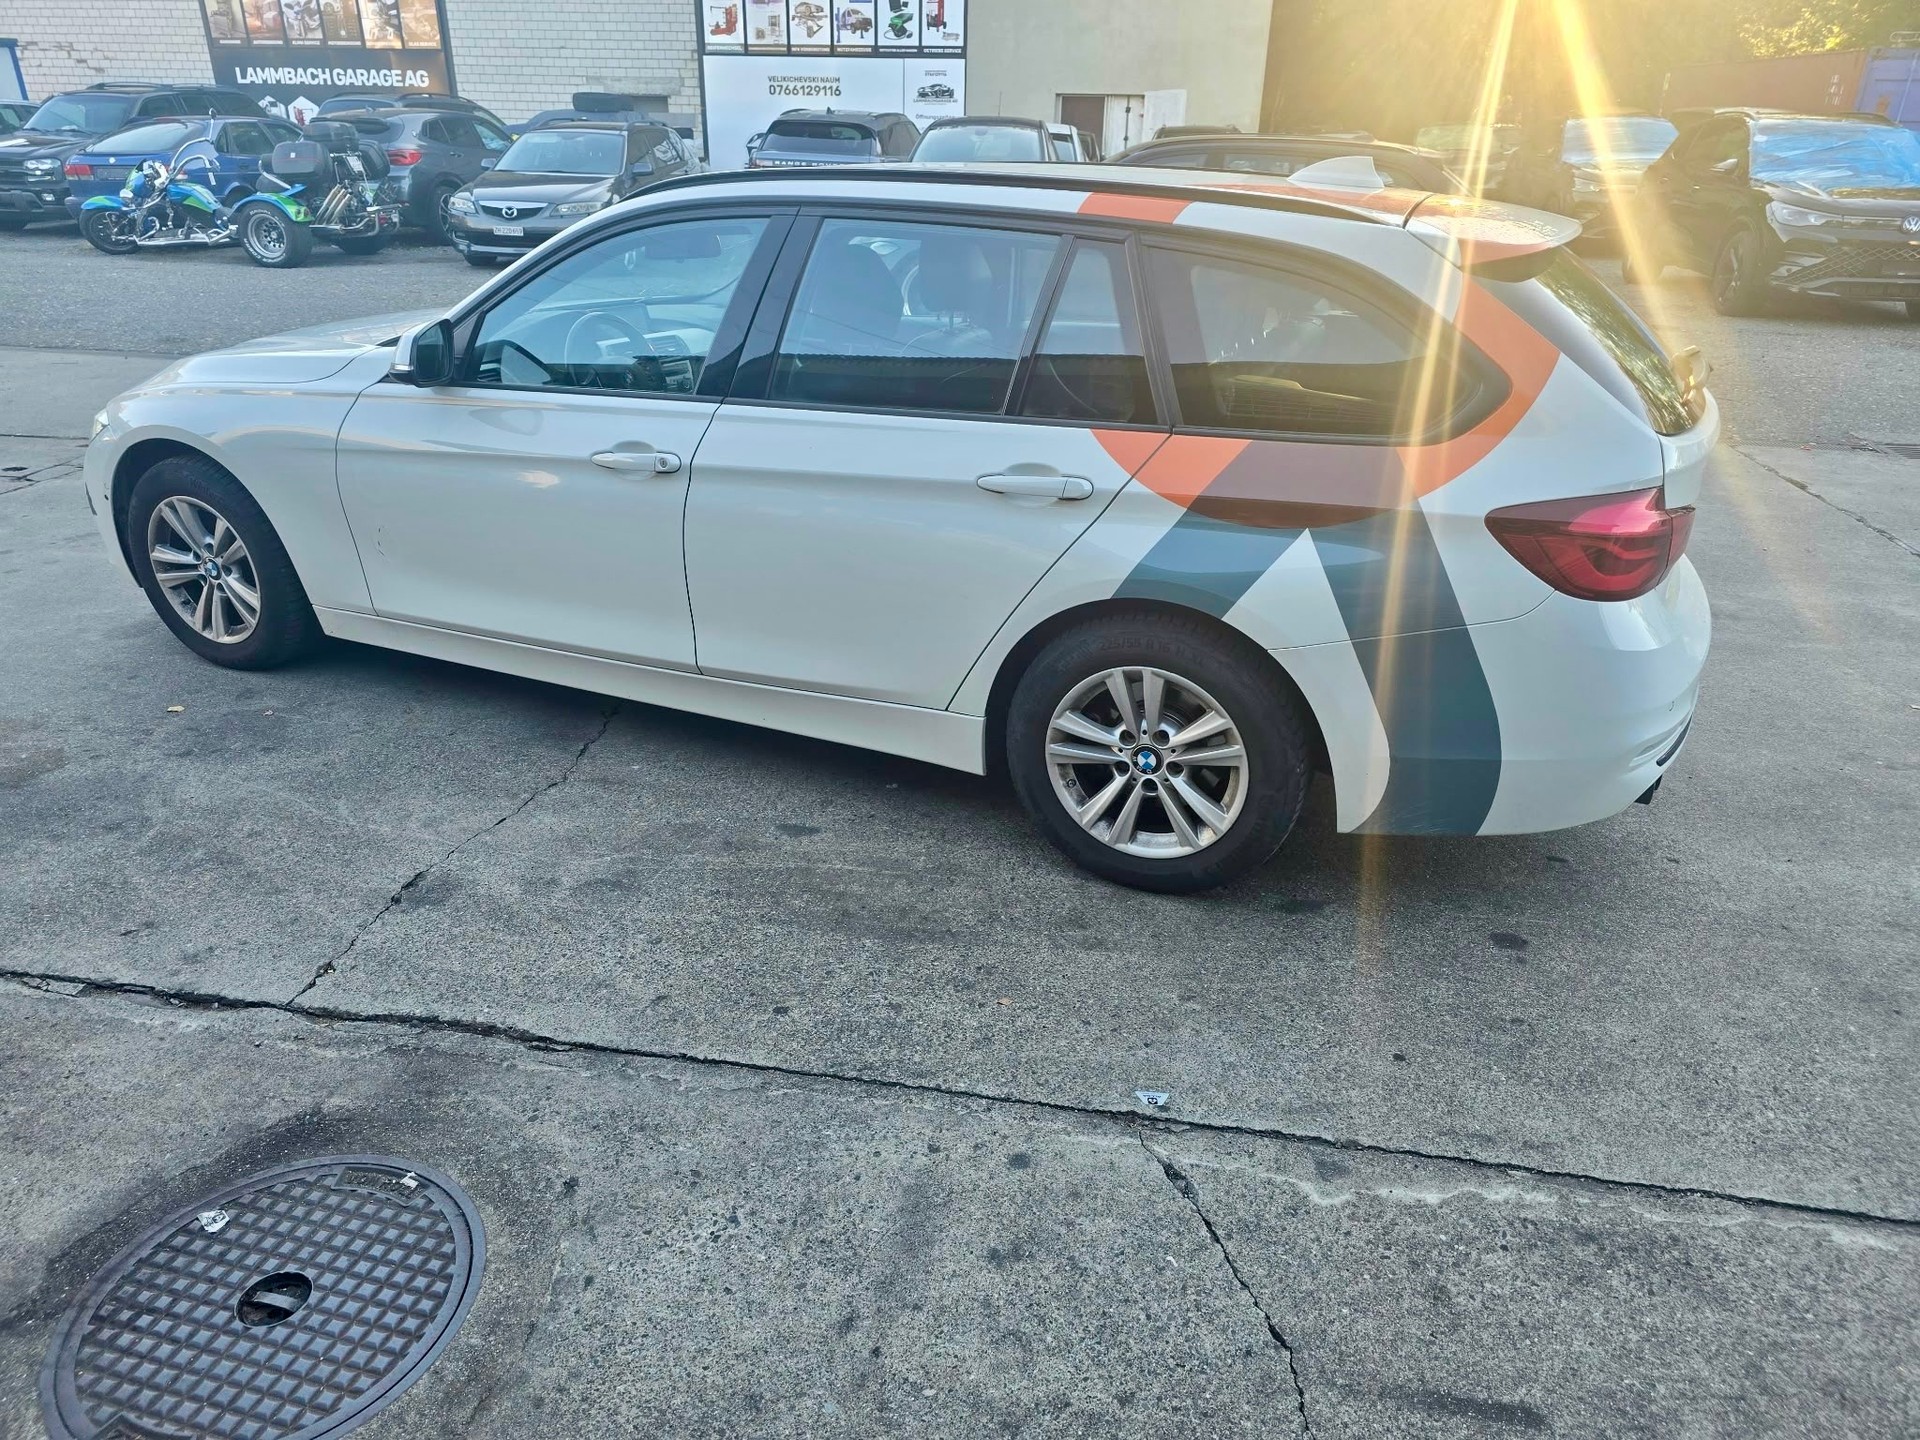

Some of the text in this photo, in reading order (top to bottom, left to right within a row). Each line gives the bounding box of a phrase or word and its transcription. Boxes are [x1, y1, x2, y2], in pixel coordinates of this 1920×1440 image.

[235, 67, 430, 87] LAMMBACH GARAGE AG
[820, 76, 841, 84] NAUM
[768, 85, 842, 97] 0766129116
